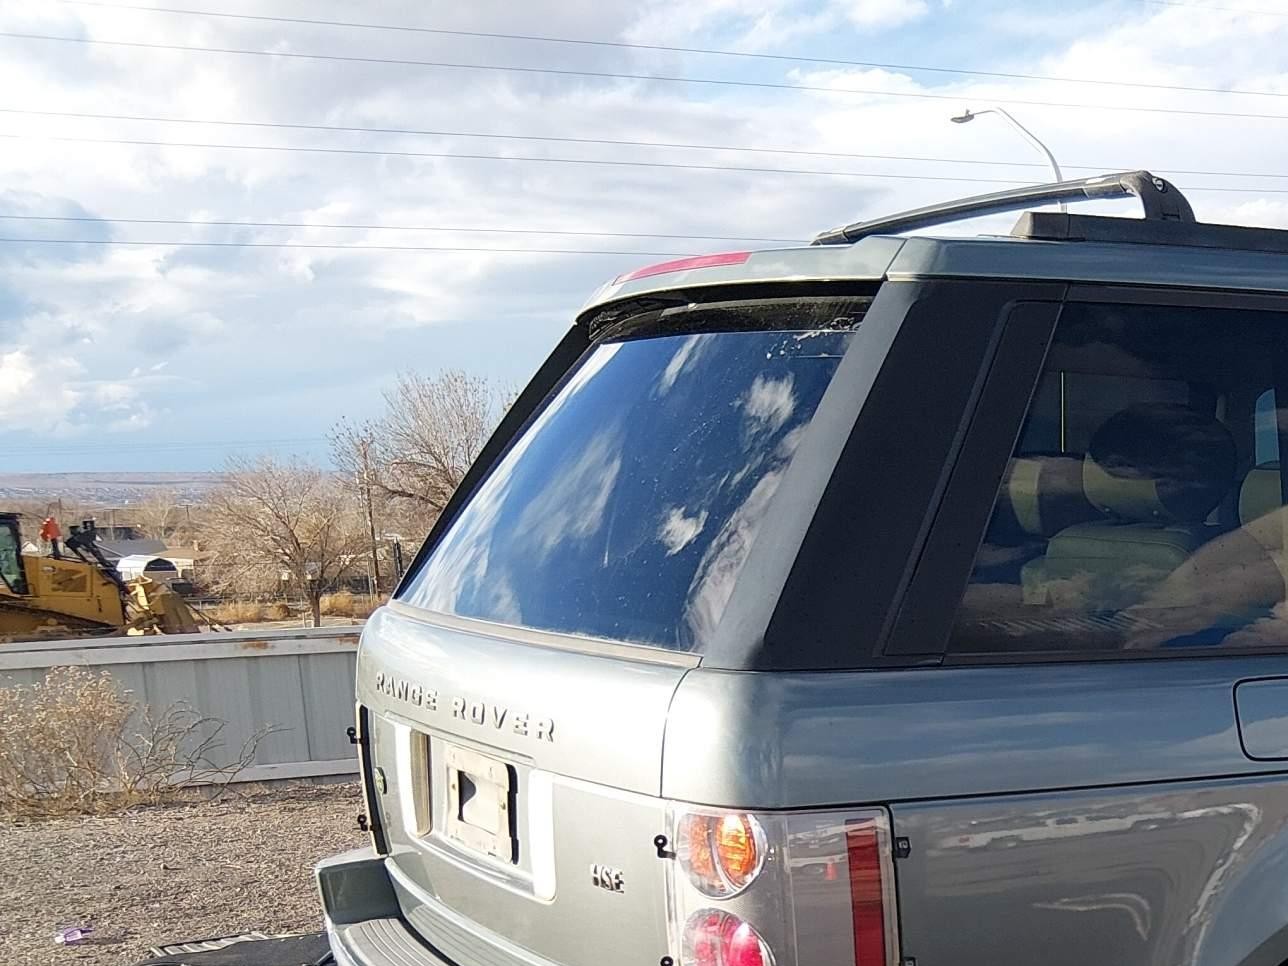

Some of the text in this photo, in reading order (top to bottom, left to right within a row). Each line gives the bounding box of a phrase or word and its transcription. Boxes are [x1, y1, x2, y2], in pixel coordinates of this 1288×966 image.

[376, 672, 556, 743] RANGE ROVER
[591, 863, 626, 894] HSE
